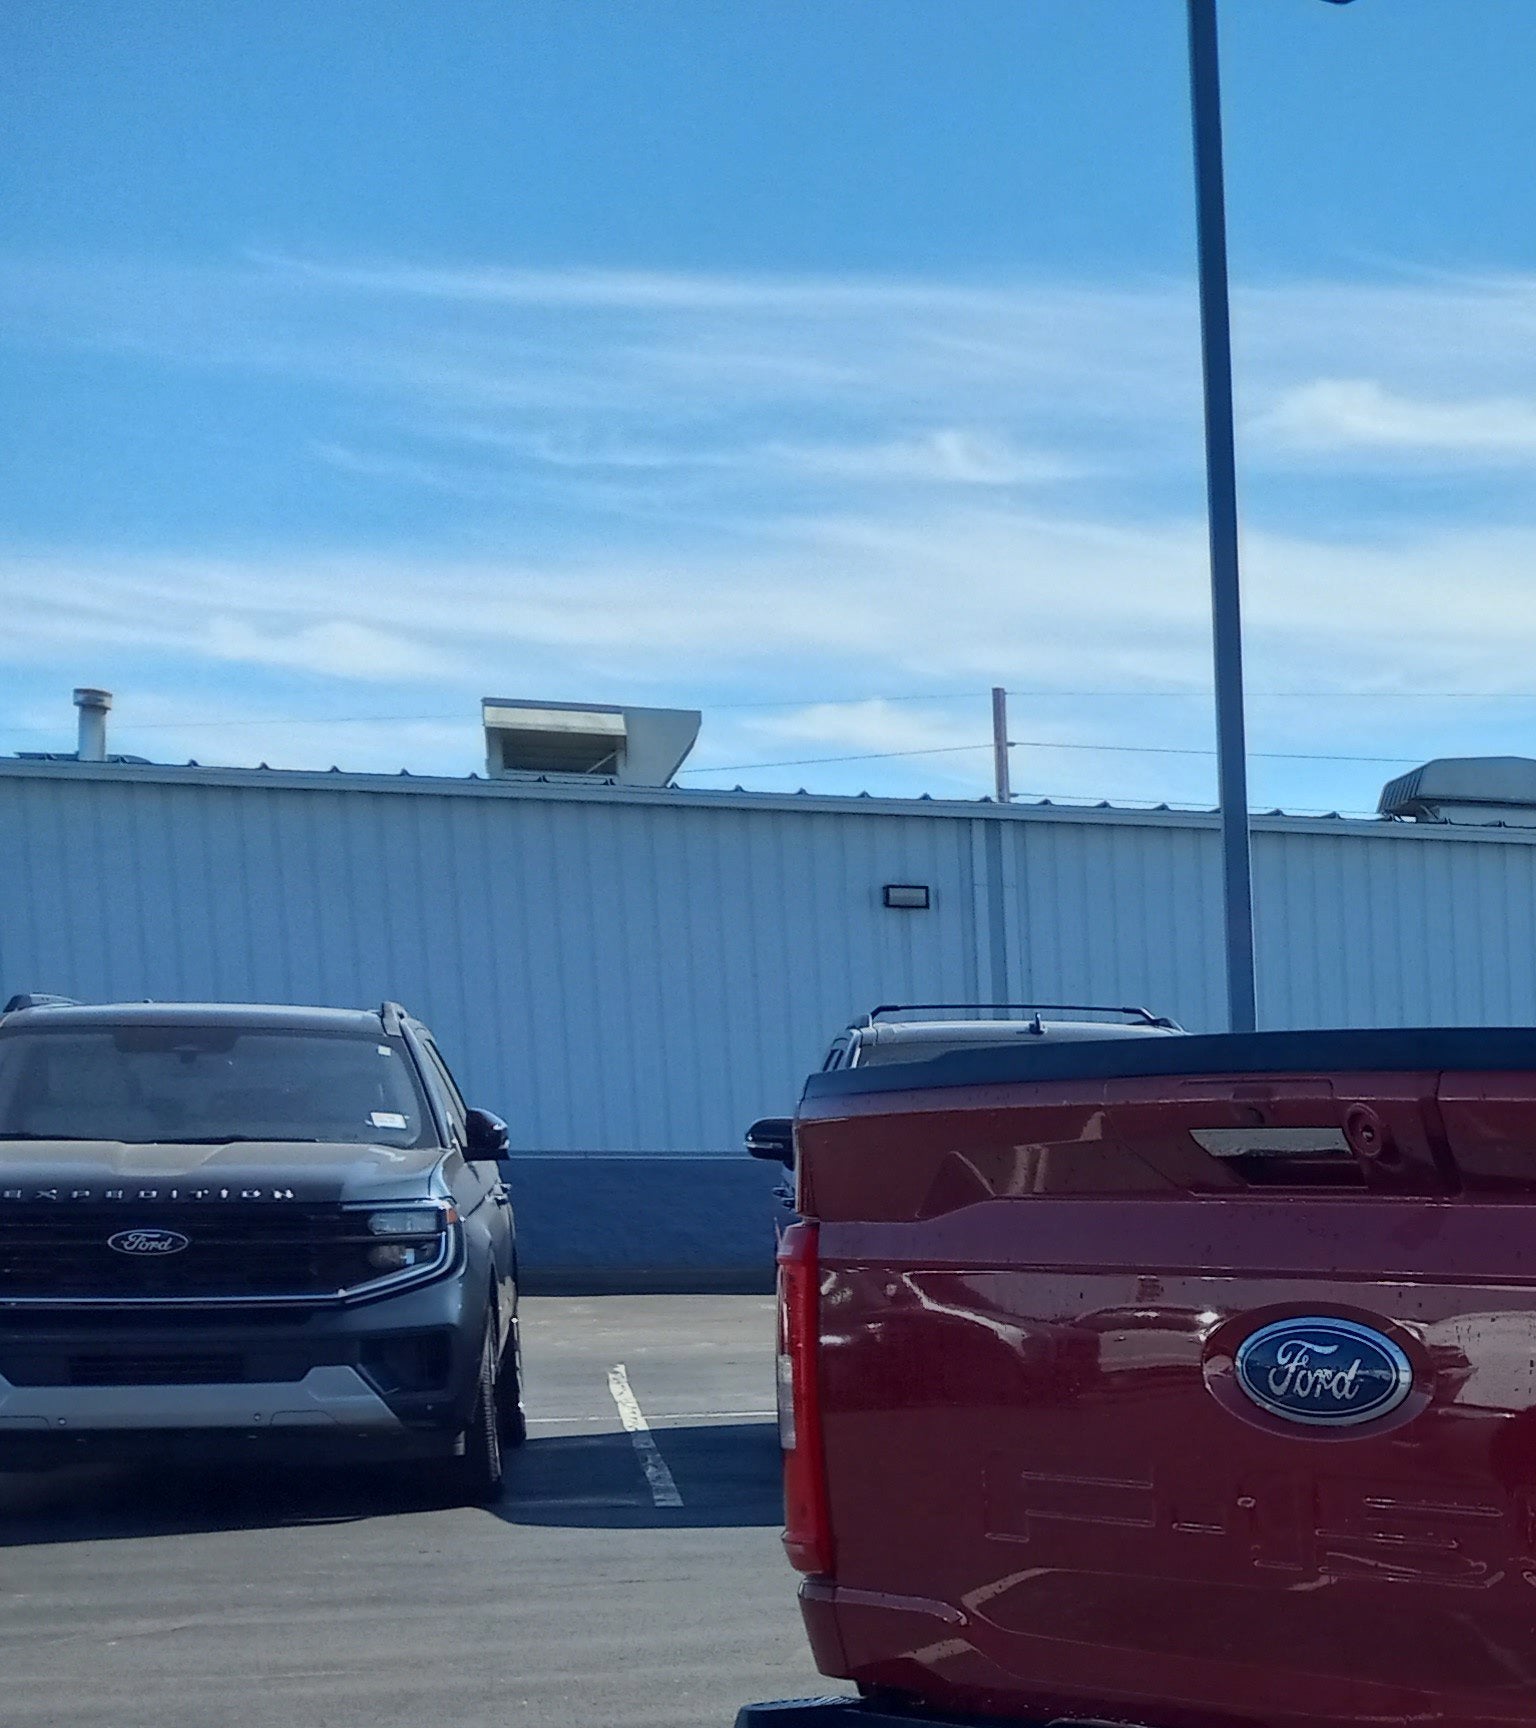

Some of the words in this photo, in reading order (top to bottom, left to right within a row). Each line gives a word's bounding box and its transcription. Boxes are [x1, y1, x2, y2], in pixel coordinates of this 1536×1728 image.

[3, 1189, 294, 1200] EXPEDITION
[121, 1232, 172, 1251] Ford
[1268, 1339, 1362, 1400] Ford
